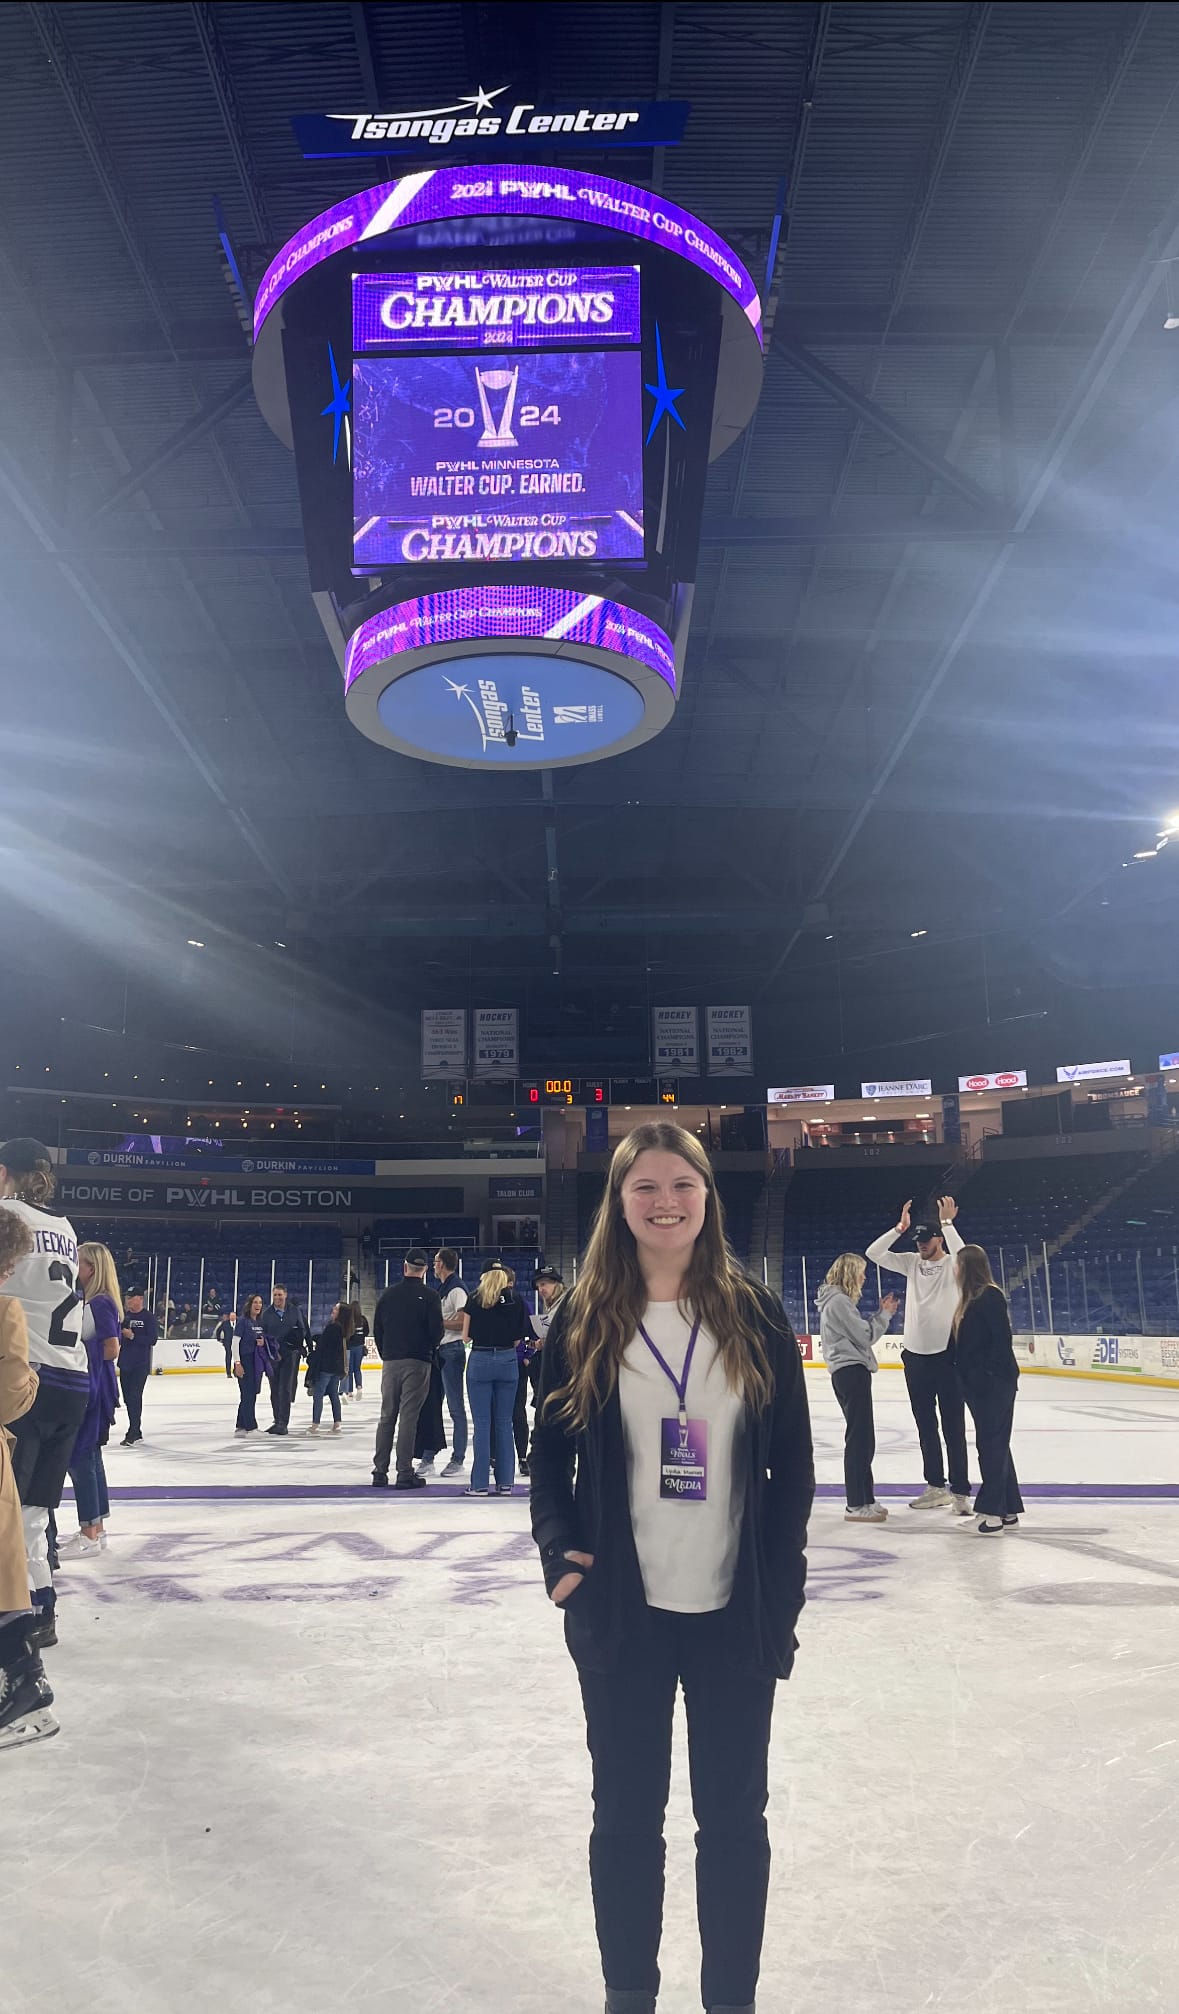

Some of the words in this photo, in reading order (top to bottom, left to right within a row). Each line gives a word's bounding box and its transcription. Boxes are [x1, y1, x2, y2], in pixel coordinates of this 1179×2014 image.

[350, 113, 502, 144] Tsongas
[505, 105, 640, 135] Center
[500, 180, 577, 201] PWHL
[417, 275, 483, 292] PWHL
[482, 273, 545, 288] WALTER
[546, 272, 578, 287] CUP
[379, 290, 616, 330] CHAMPIONS
[433, 407, 476, 429] 20
[519, 404, 562, 427] 24
[435, 460, 480, 473] PWHL
[481, 458, 561, 470] MINNESOTA
[410, 474, 475, 497] WALTER
[478, 473, 516, 496] CUP.
[519, 471, 587, 495] EARNED.
[431, 514, 488, 530] PWHL
[487, 513, 540, 528] WALTER
[540, 512, 567, 527] CUP
[400, 527, 599, 562] CHAMPIONS
[477, 679, 509, 743] Tsongas
[517, 685, 545, 741] Center
[479, 1012, 513, 1022] HOCKEY
[658, 1010, 692, 1020] HOCKEY
[711, 1009, 745, 1019] HOCKEY
[483, 1050, 511, 1058] 1979
[717, 1047, 745, 1056] 1982
[545, 1080, 572, 1093] 00.0
[968, 1079, 988, 1088] Hood
[996, 1076, 1017, 1086] Hood
[530, 1089, 539, 1102] 0
[566, 1094, 573, 1104] 3
[595, 1088, 603, 1101] 3
[661, 1093, 675, 1103] 44
[103, 1153, 144, 1165] DURKIN
[145, 1159, 186, 1167] PAVILION
[256, 1159, 296, 1171] DURKIN
[297, 1164, 339, 1172] PAVILION
[61, 1185, 123, 1202] HOME
[128, 1188, 155, 1202] OF
[166, 1187, 246, 1208] PWHL
[251, 1189, 353, 1207] BOSTON
[48, 1260, 79, 1347] 2
[1100, 1337, 1119, 1364] DEI
[664, 1478, 702, 1493] MEDIA
